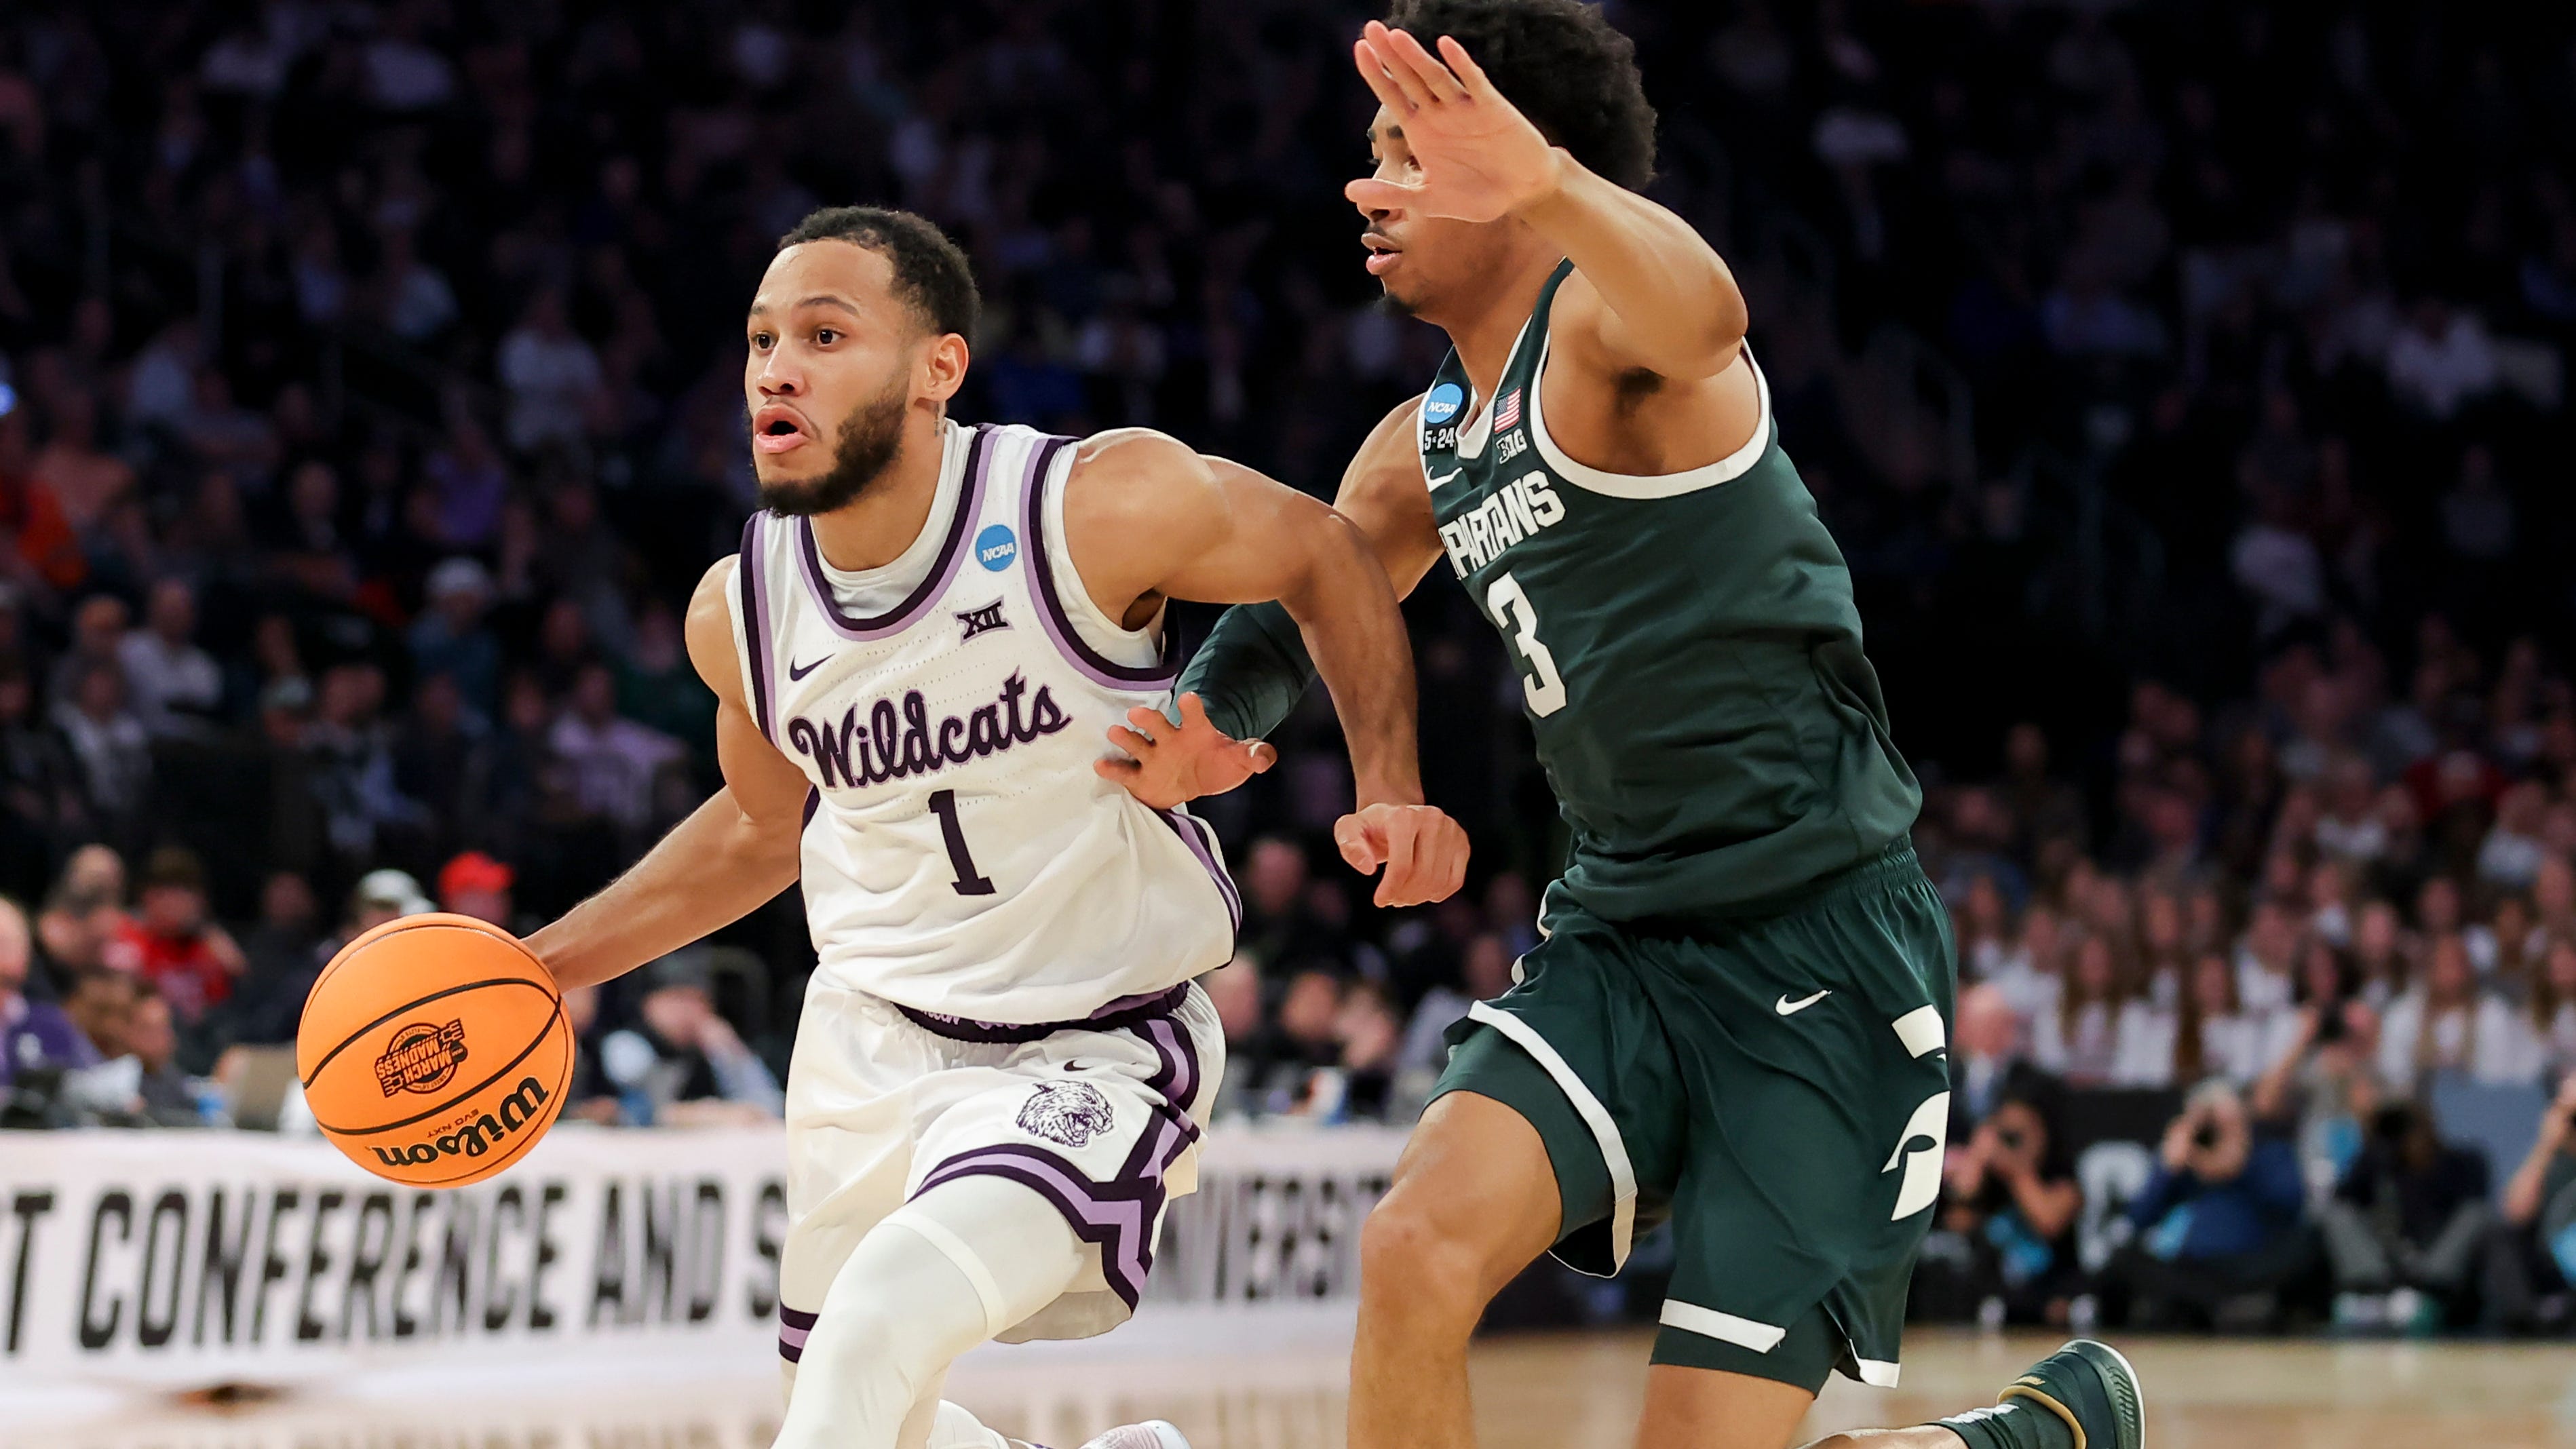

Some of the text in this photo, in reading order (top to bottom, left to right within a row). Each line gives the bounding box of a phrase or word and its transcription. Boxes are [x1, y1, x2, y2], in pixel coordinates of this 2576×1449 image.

[1427, 401, 1457, 415] NCAA
[982, 542, 1015, 562] NCAA
[1438, 469, 1566, 581] PARTANS
[955, 599, 1010, 640] XII
[1487, 571, 1567, 718] 3
[788, 665, 1073, 789] Wildcats
[929, 789, 997, 895] 1
[375, 1037, 440, 1079] MADNESS
[403, 1049, 453, 1084] MARCH
[370, 1077, 550, 1167] Wilson
[427, 1108, 480, 1138] EVO NXT
[78, 1182, 566, 1351] CONFERENCE
[588, 1178, 726, 1331] AND
